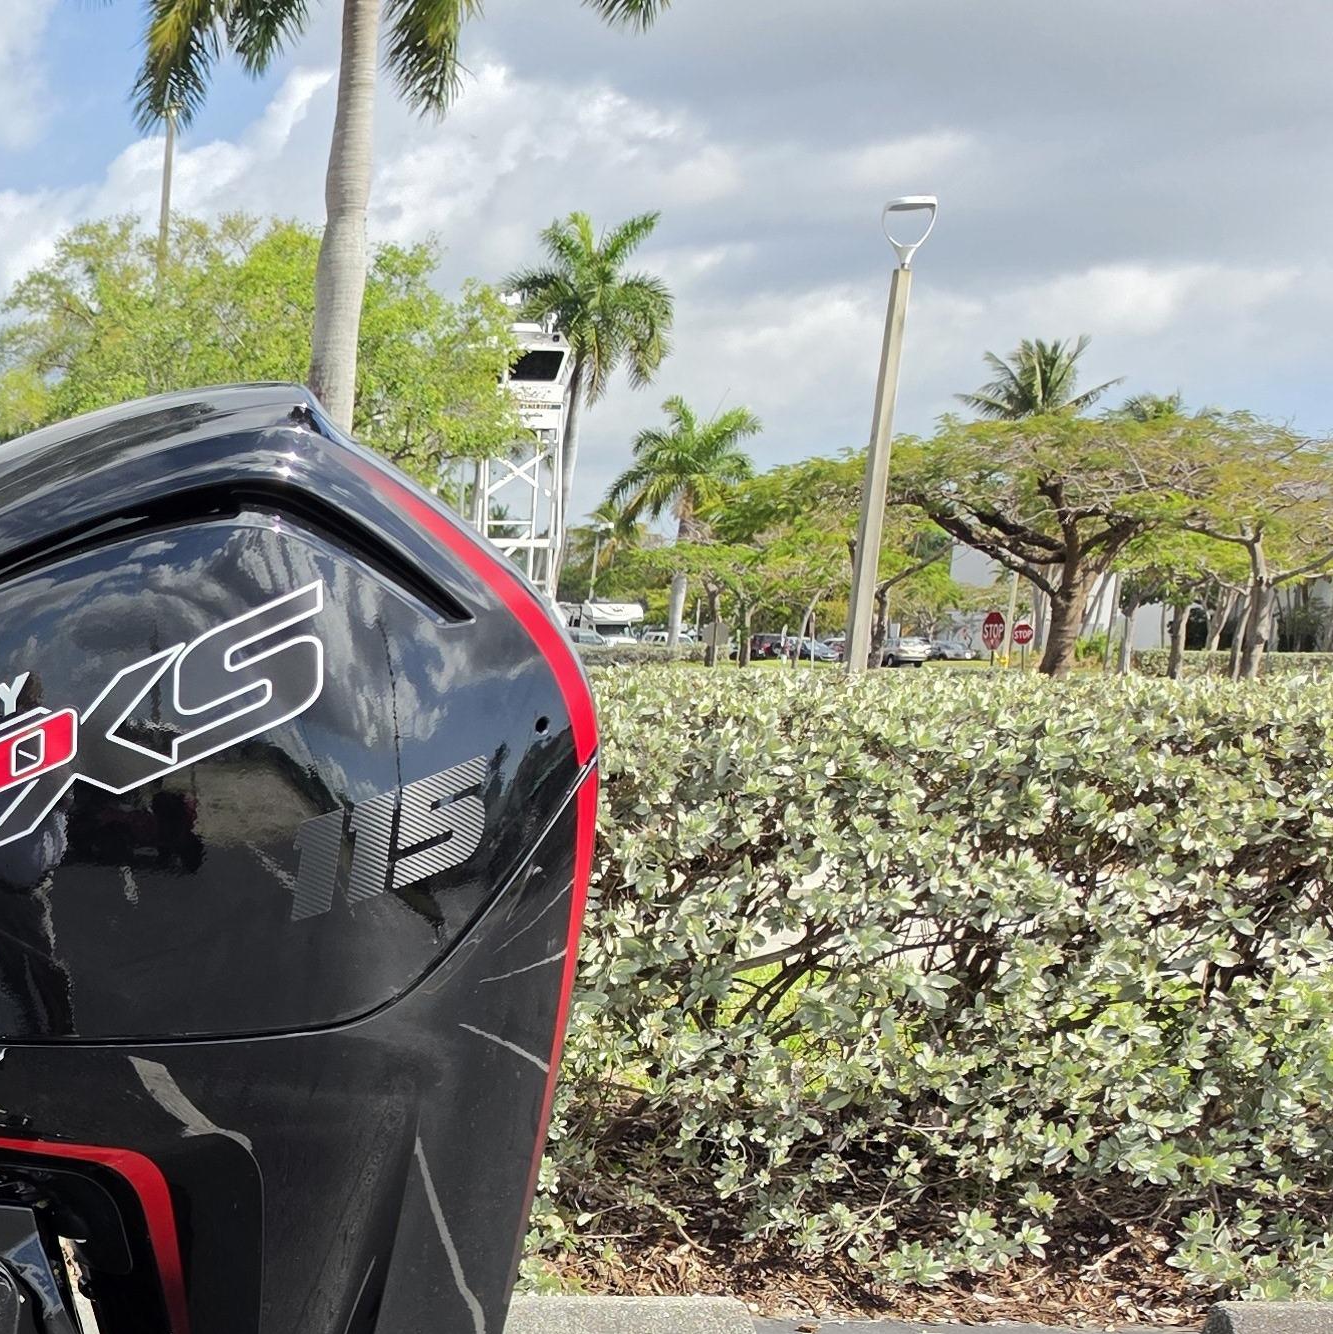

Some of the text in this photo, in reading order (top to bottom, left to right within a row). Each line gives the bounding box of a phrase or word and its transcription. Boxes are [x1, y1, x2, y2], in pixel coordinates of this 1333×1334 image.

[983, 623, 1004, 639] STOP
[1014, 630, 1033, 640] STOP
[290, 753, 490, 922] 115
